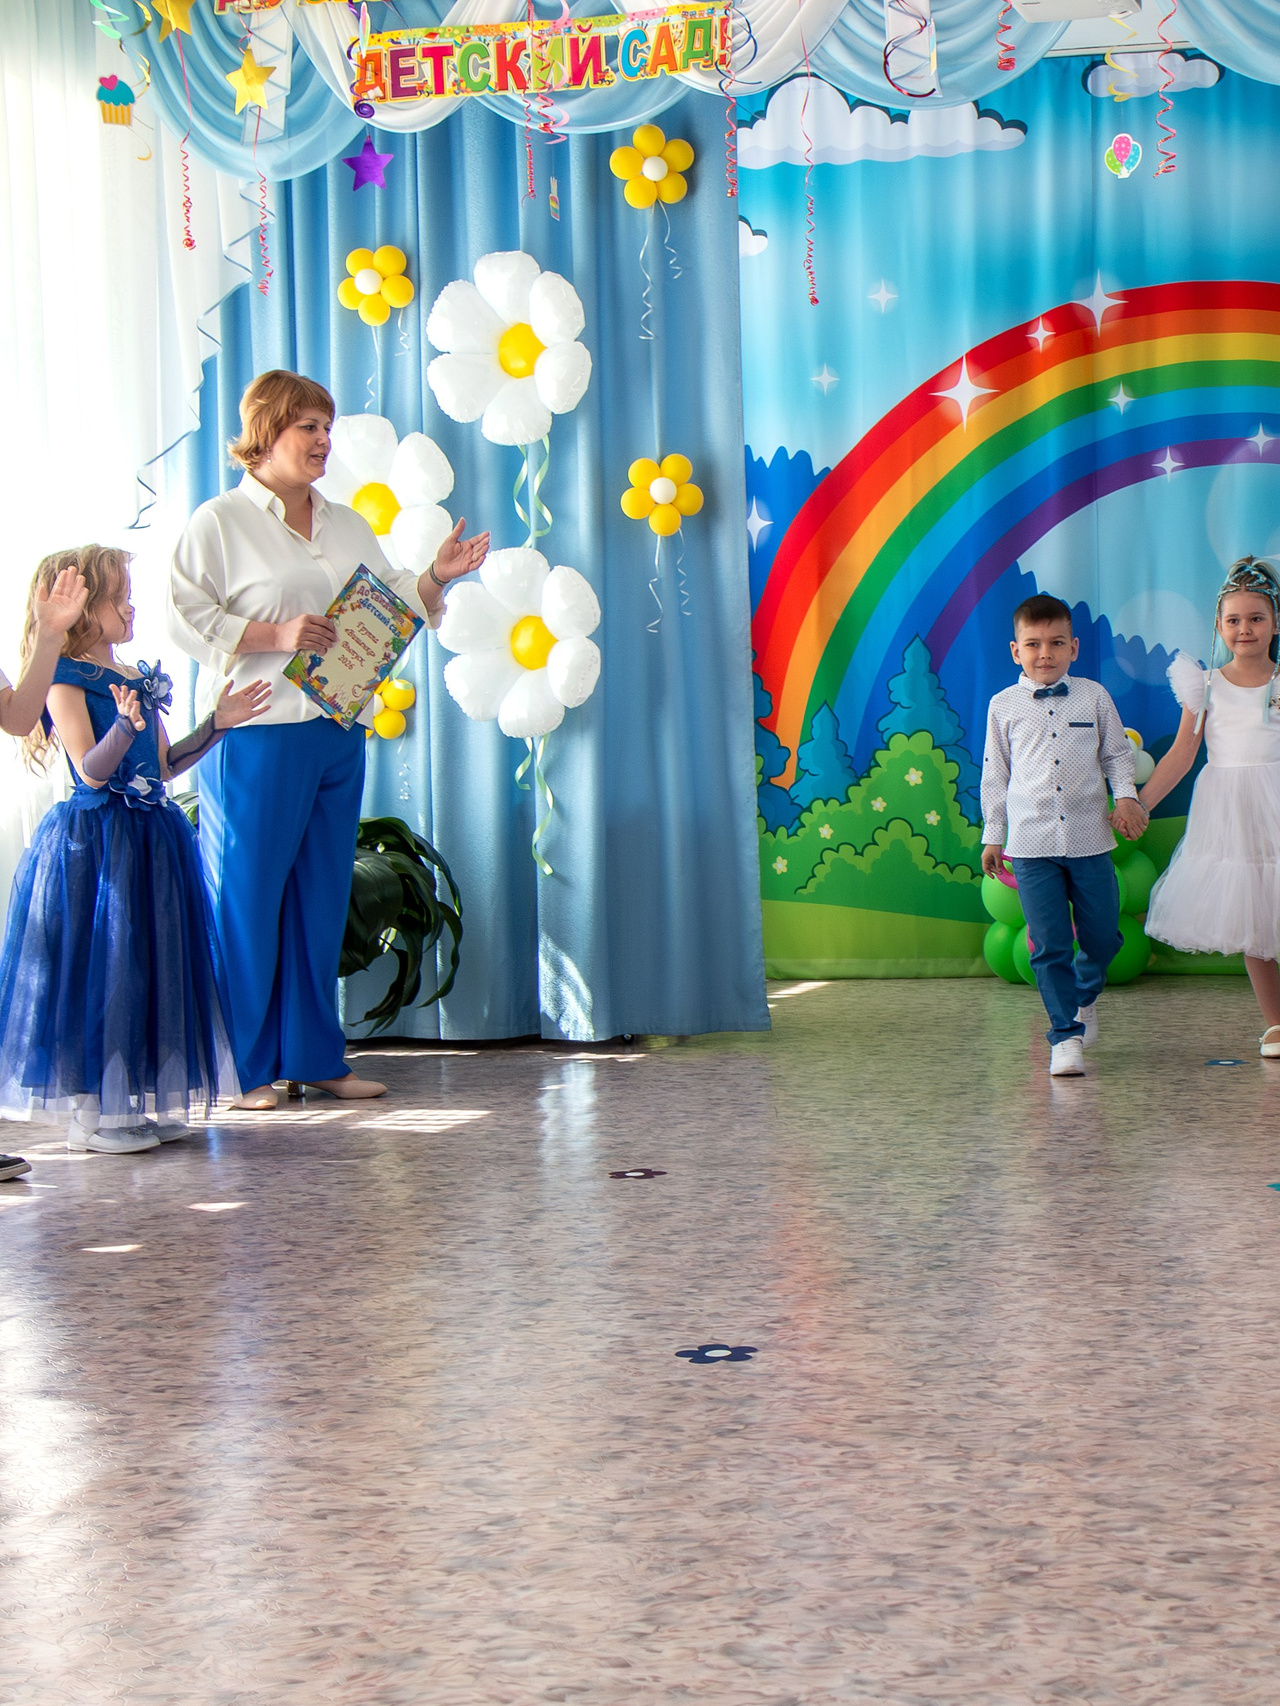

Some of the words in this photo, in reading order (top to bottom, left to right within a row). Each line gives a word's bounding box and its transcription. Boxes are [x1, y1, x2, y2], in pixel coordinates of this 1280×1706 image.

[355, 22, 607, 101] ДЕТСКИЙ
[356, 621, 379, 644] Группа
[389, 623, 402, 638] сад
[337, 654, 356, 670] 2026
[341, 641, 366, 667] Выпуск
